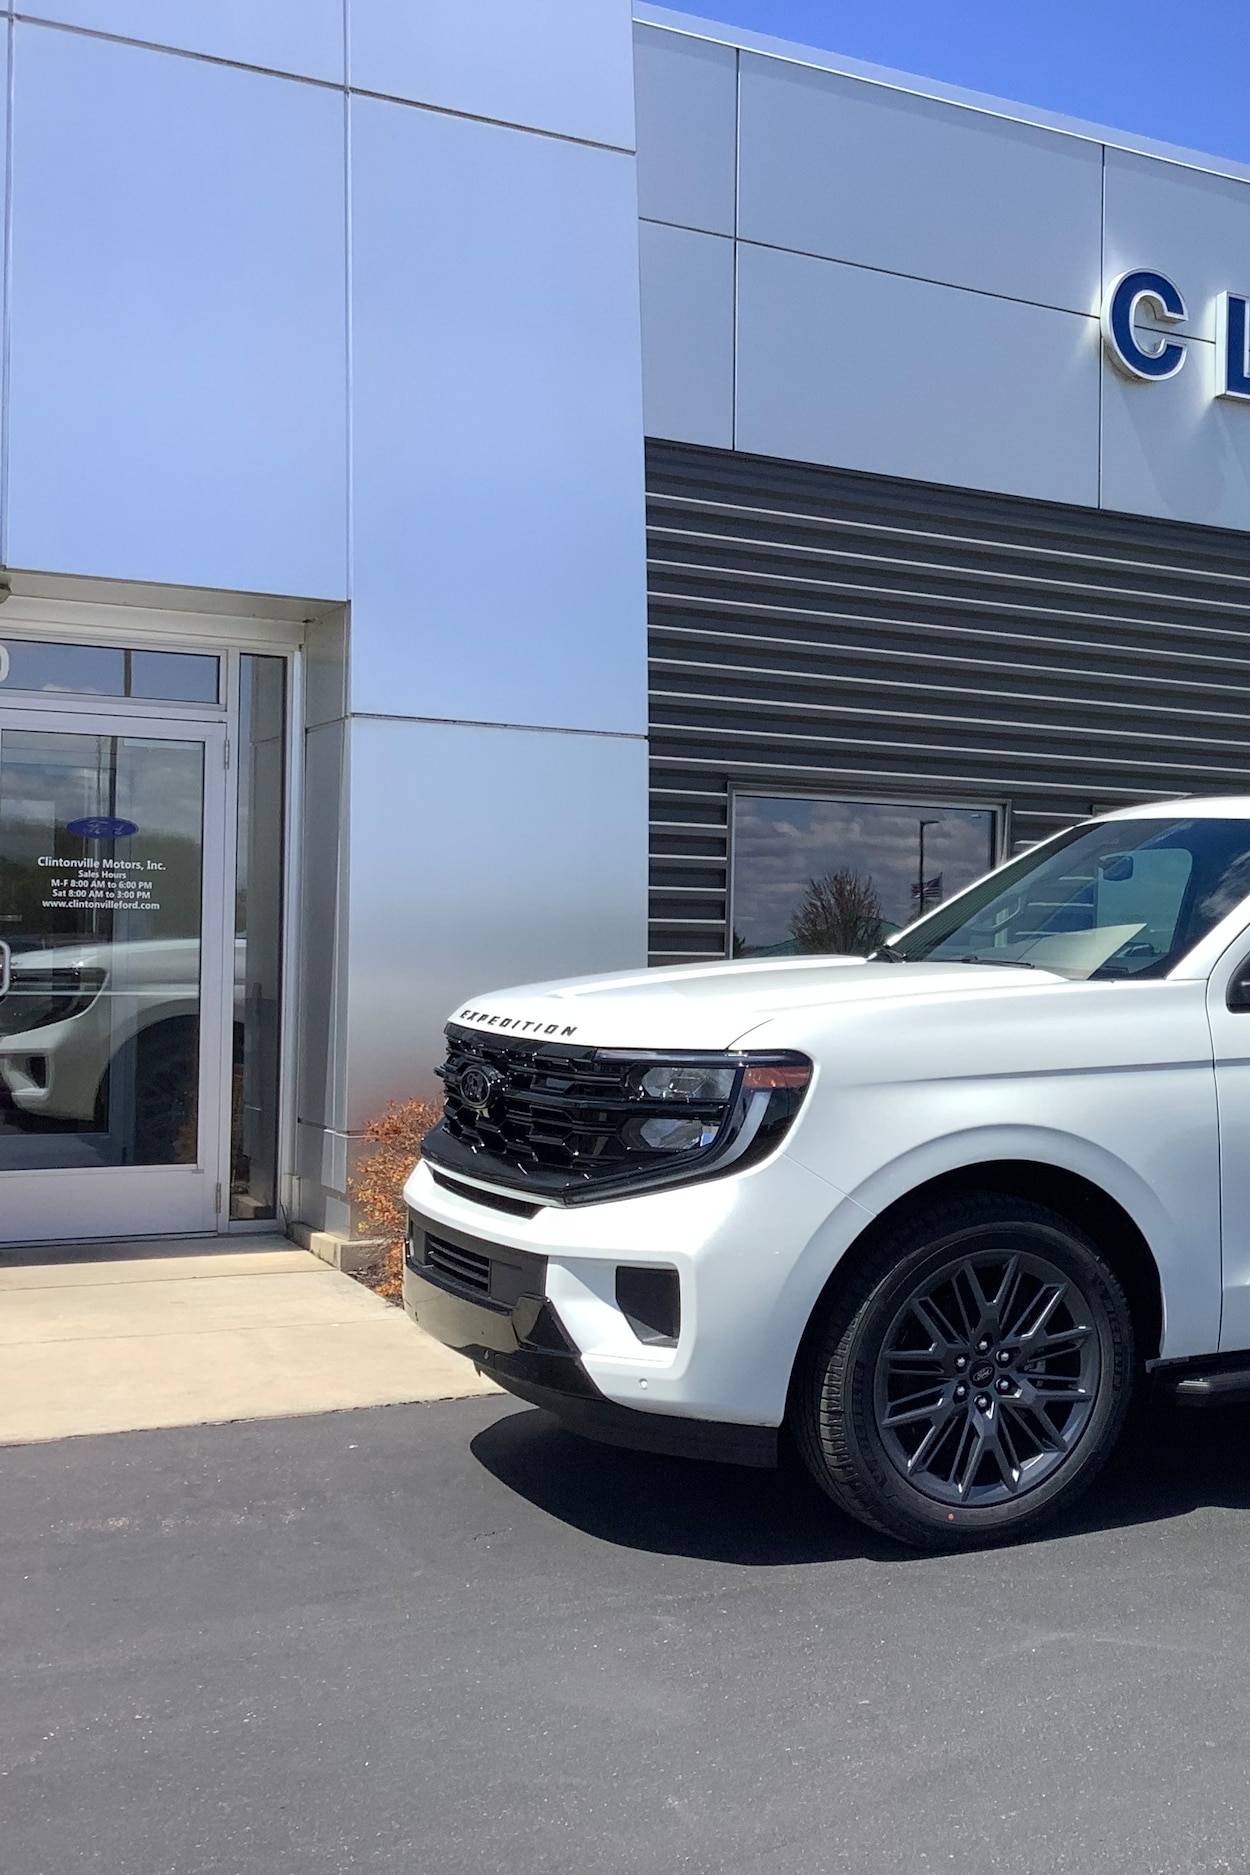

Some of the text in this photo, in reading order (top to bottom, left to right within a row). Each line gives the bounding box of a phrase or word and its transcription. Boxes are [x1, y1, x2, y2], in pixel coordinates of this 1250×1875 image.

[38, 856, 166, 871] Clintonville Motors, Inc.
[78, 870, 126, 879] Sales Hours
[51, 879, 68, 887] M-F
[91, 880, 105, 888] AM
[119, 881, 136, 889] 6:00
[139, 881, 152, 889] PM
[52, 889, 151, 899] Sat 8:00 AM to 3:00 PM
[42, 899, 160, 910] www.clintonvilleford.com
[459, 1009, 578, 1037] EXPEDITION
